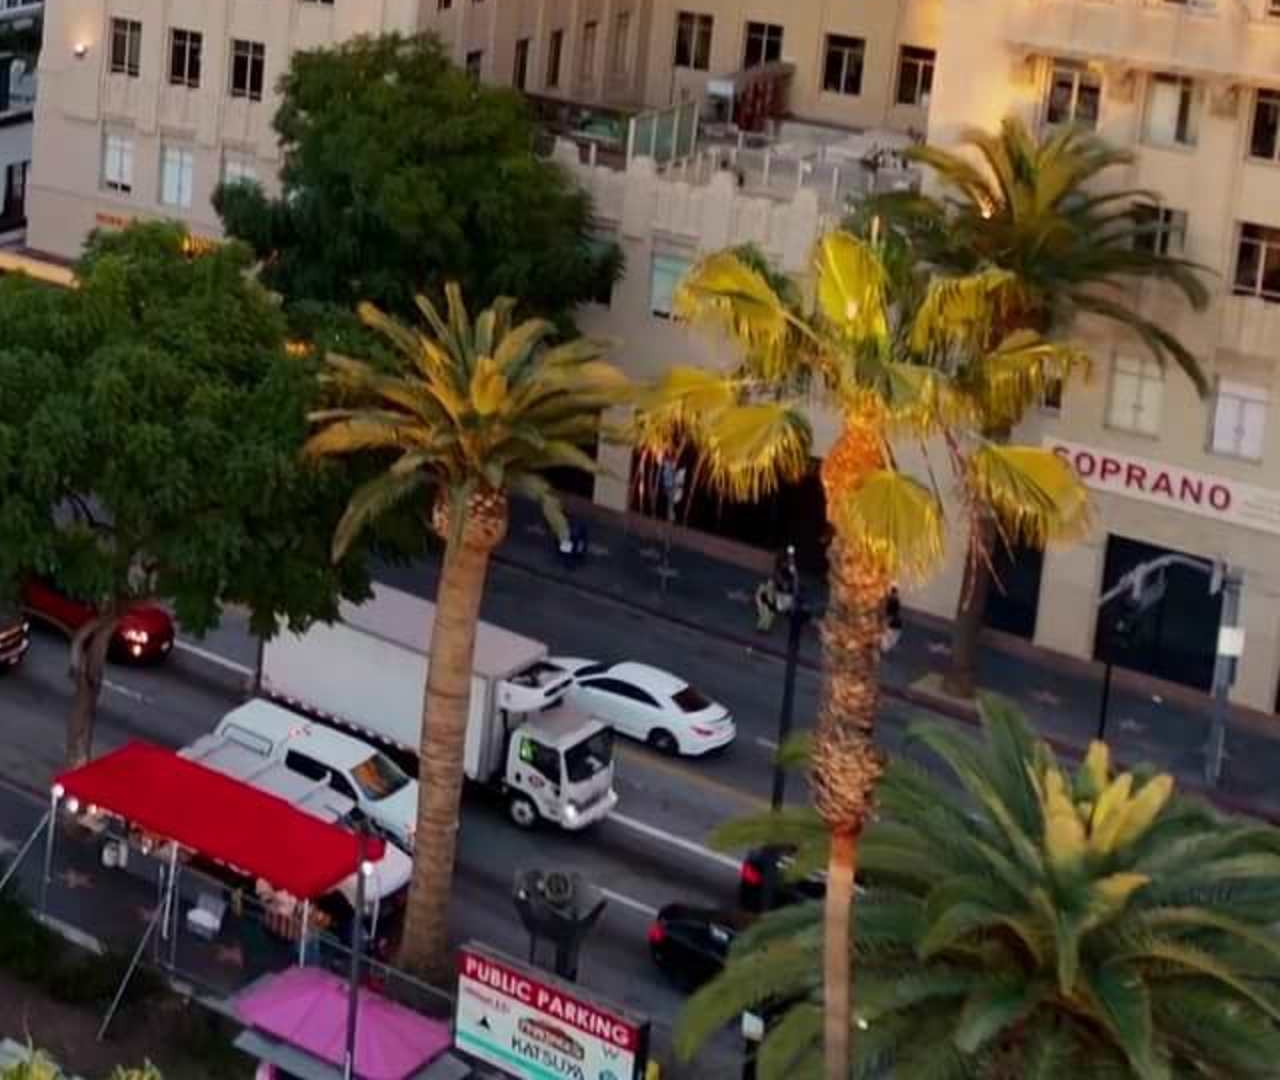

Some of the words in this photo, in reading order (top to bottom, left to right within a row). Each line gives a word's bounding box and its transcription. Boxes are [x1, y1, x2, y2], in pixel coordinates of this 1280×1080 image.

[465, 956, 532, 1003] PUBLIC
[536, 989, 630, 1046] PARKING
[511, 1035, 585, 1080] KATSUYA
